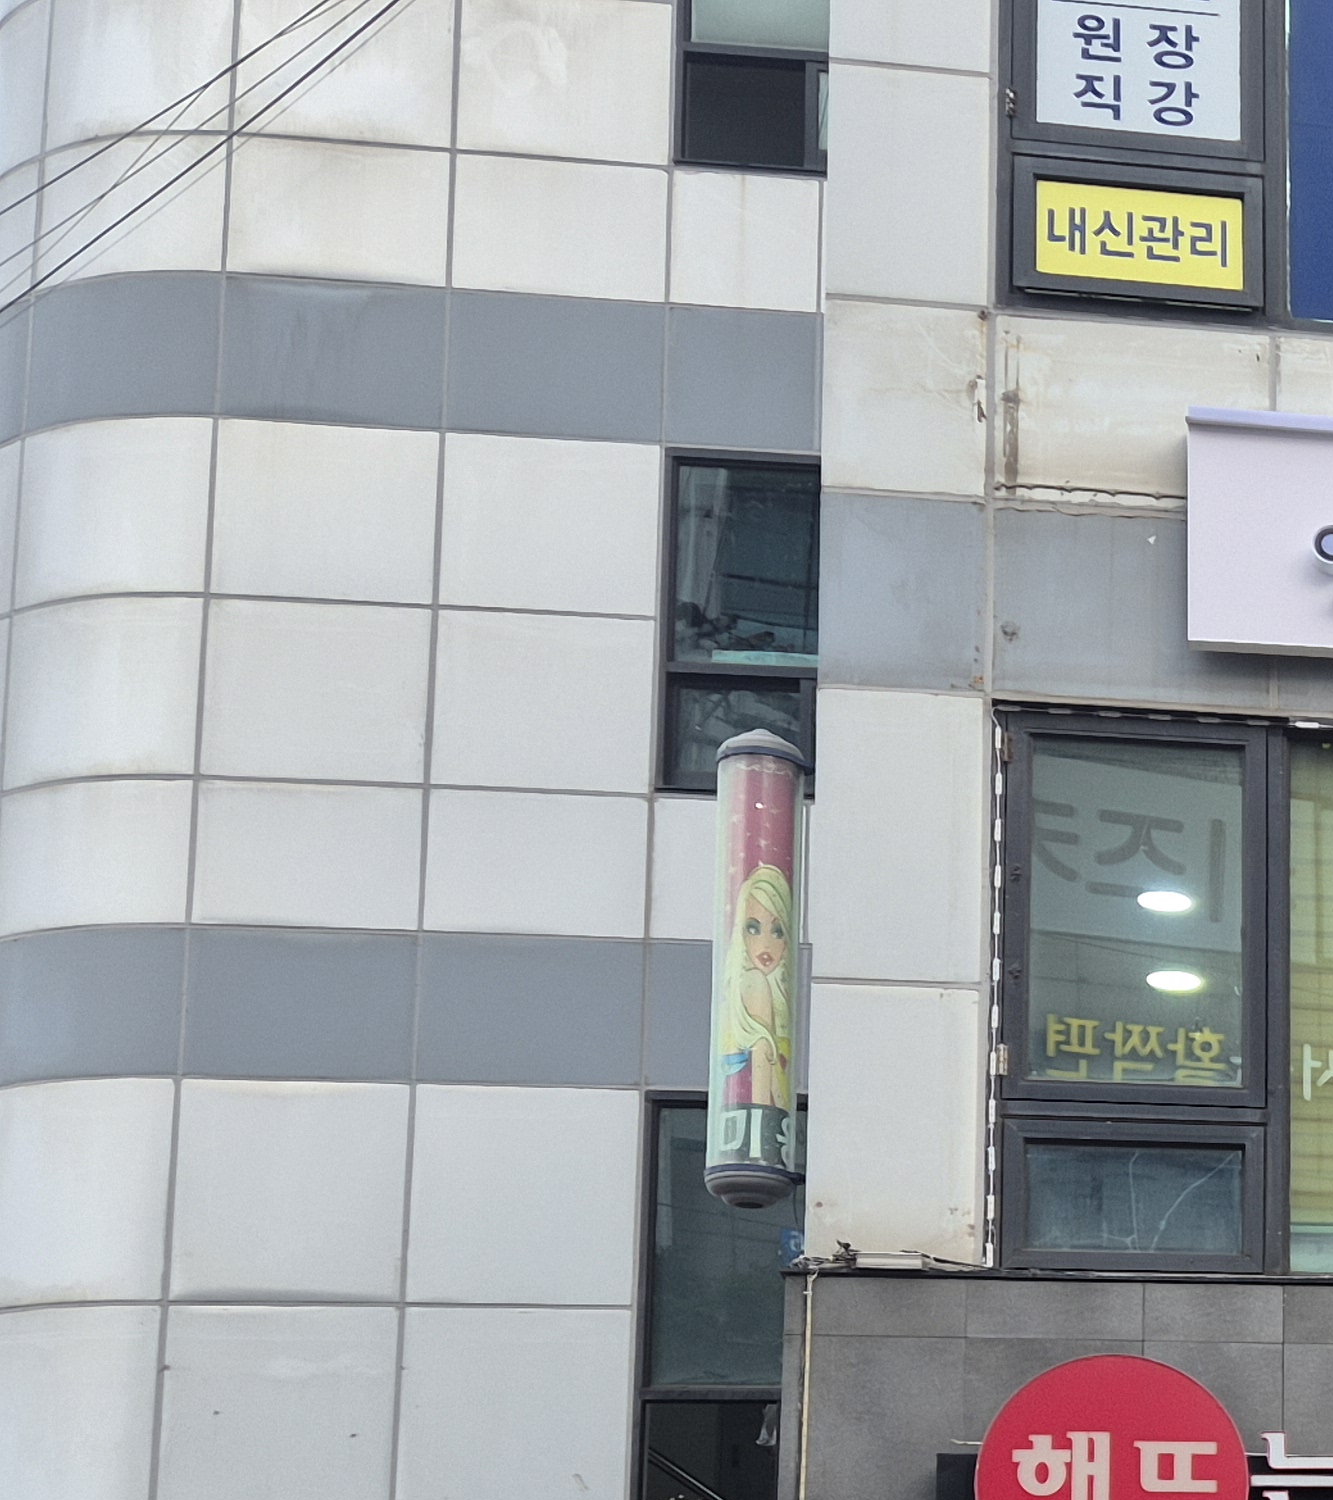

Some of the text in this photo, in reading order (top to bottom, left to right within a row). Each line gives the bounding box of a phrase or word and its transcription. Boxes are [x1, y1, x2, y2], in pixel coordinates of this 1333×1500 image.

[1071, 13, 1201, 70] 원장
[1072, 72, 1201, 127] 직강
[1045, 205, 1231, 269] 내신관리
